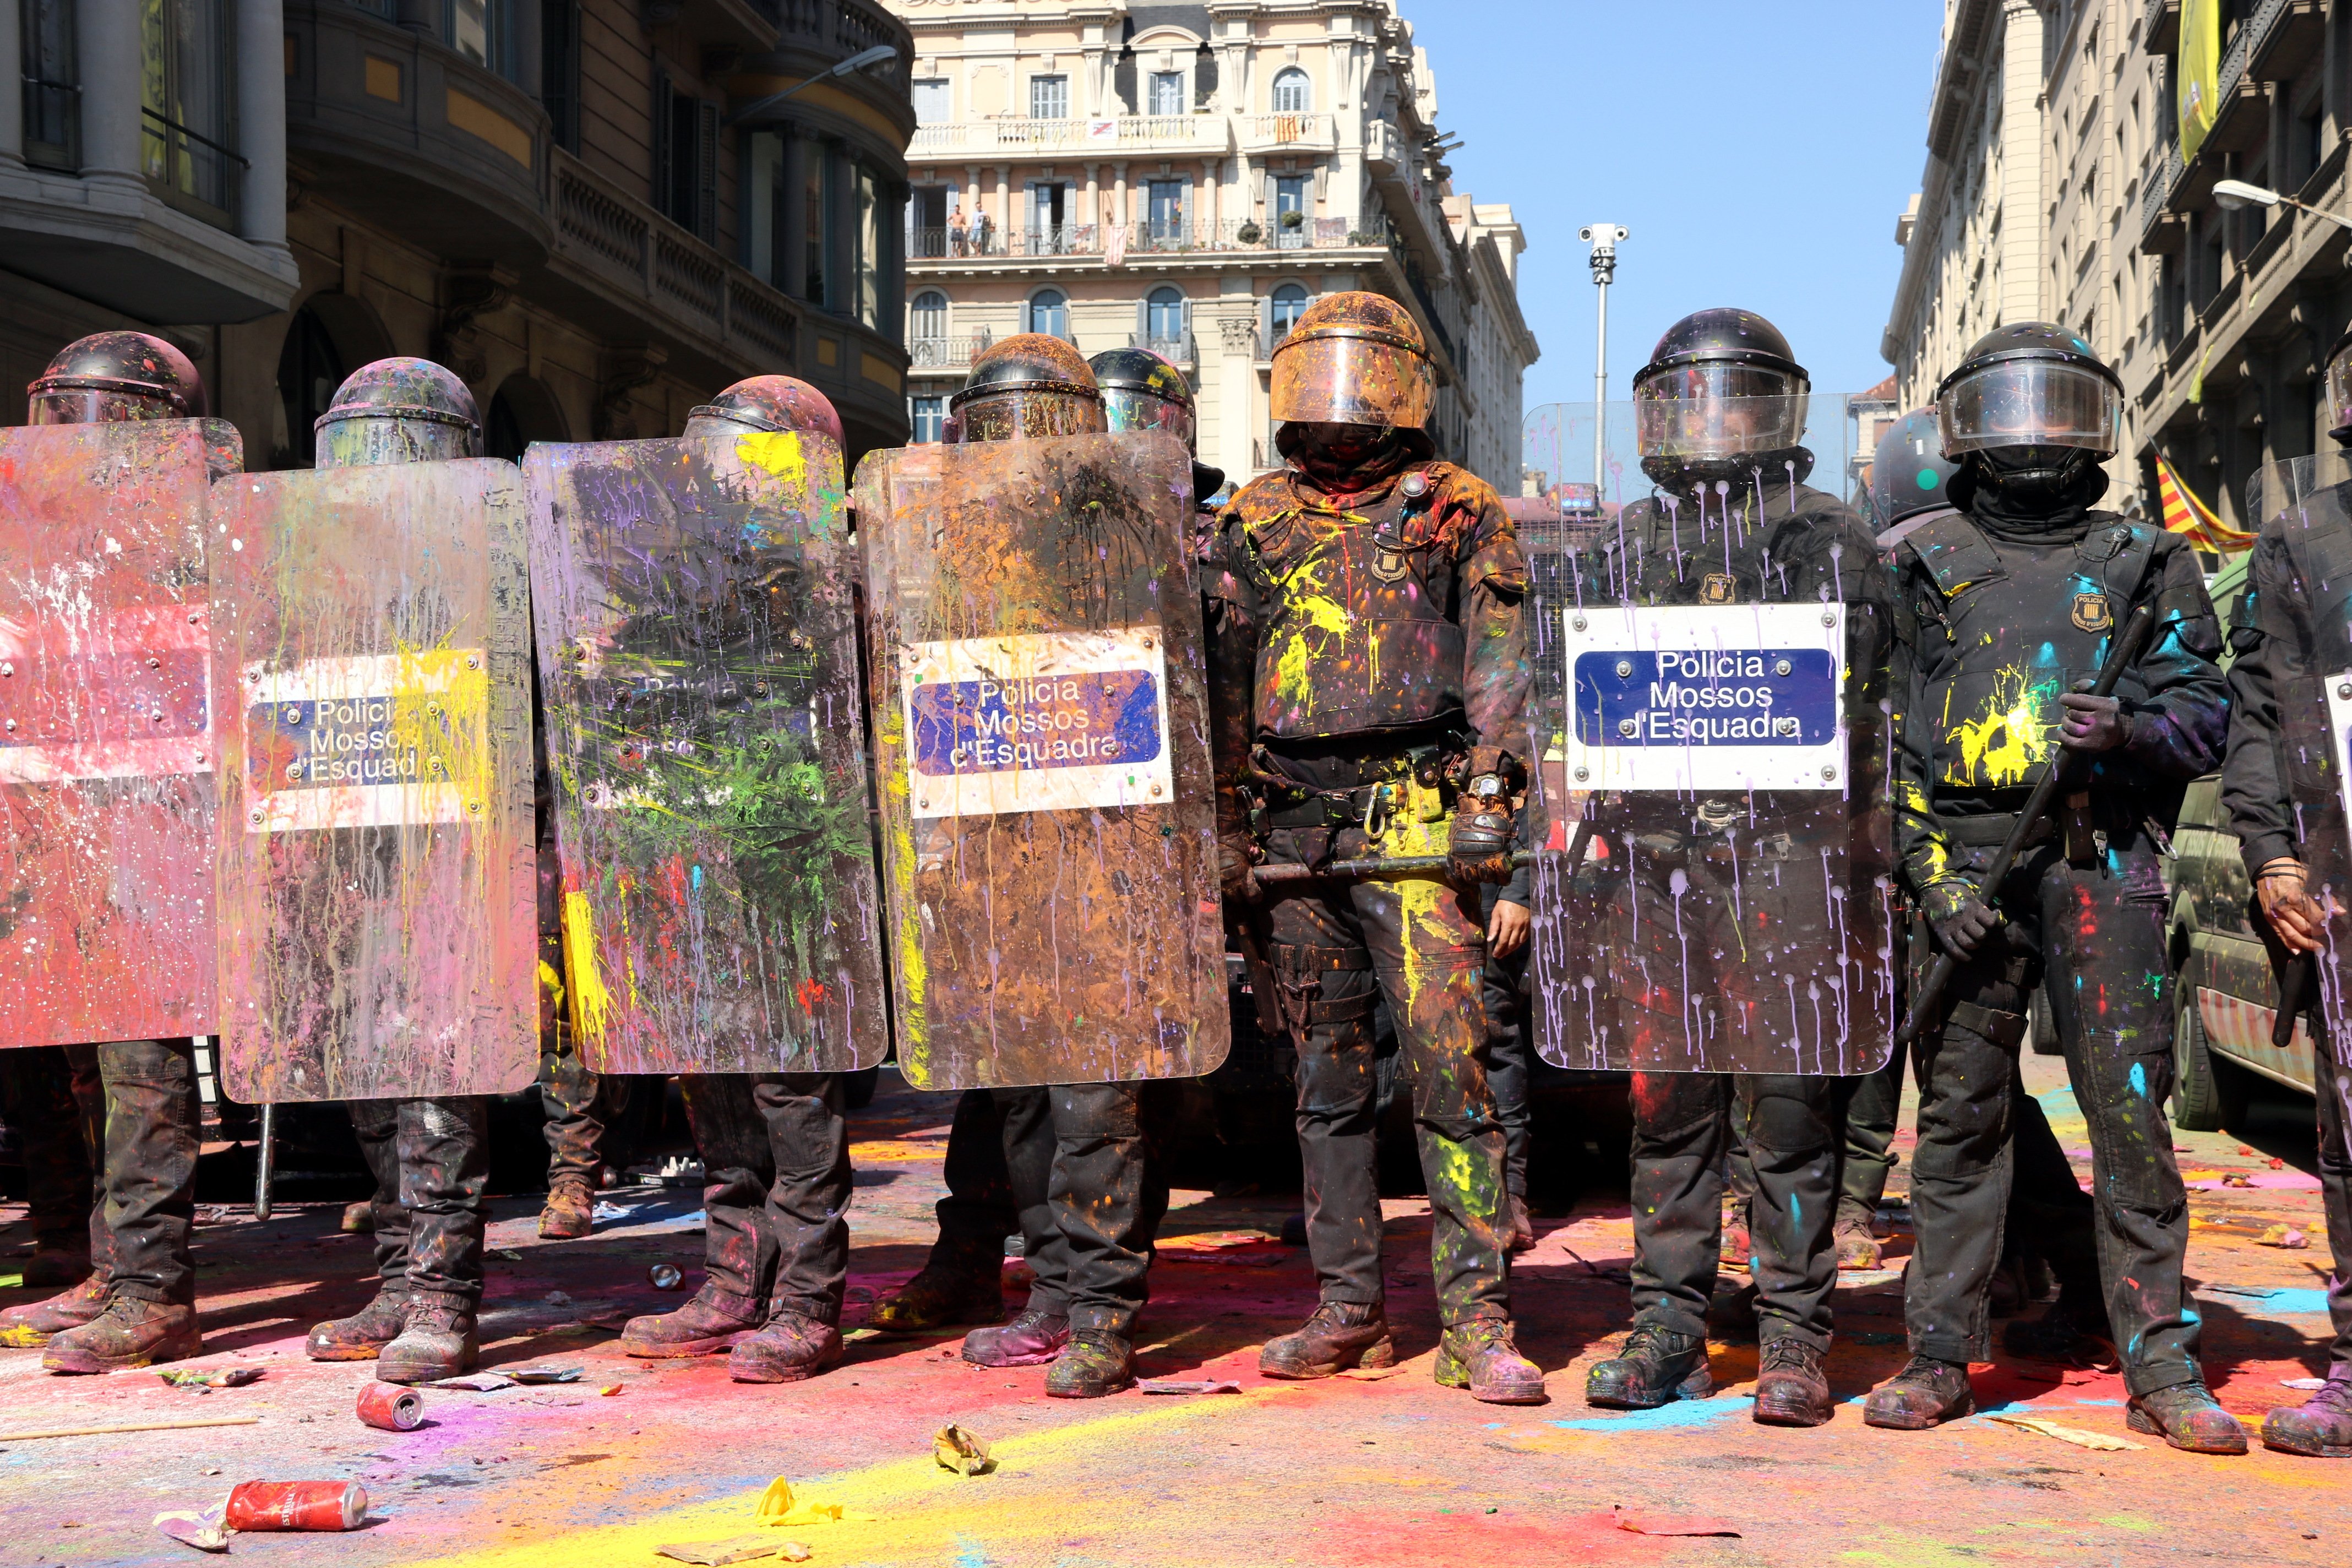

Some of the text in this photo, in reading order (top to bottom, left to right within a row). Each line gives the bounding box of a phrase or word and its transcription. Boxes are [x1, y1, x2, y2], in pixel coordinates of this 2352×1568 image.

[1658, 651, 1765, 678] Policia
[981, 676, 1080, 707] Policia
[1650, 681, 1773, 709] Mossos
[974, 708, 1090, 737] Mossos
[1622, 711, 1802, 745] d'Esquadra
[950, 732, 1119, 769] d'Esquadra
[282, 1493, 296, 1526] ESTRELLA
